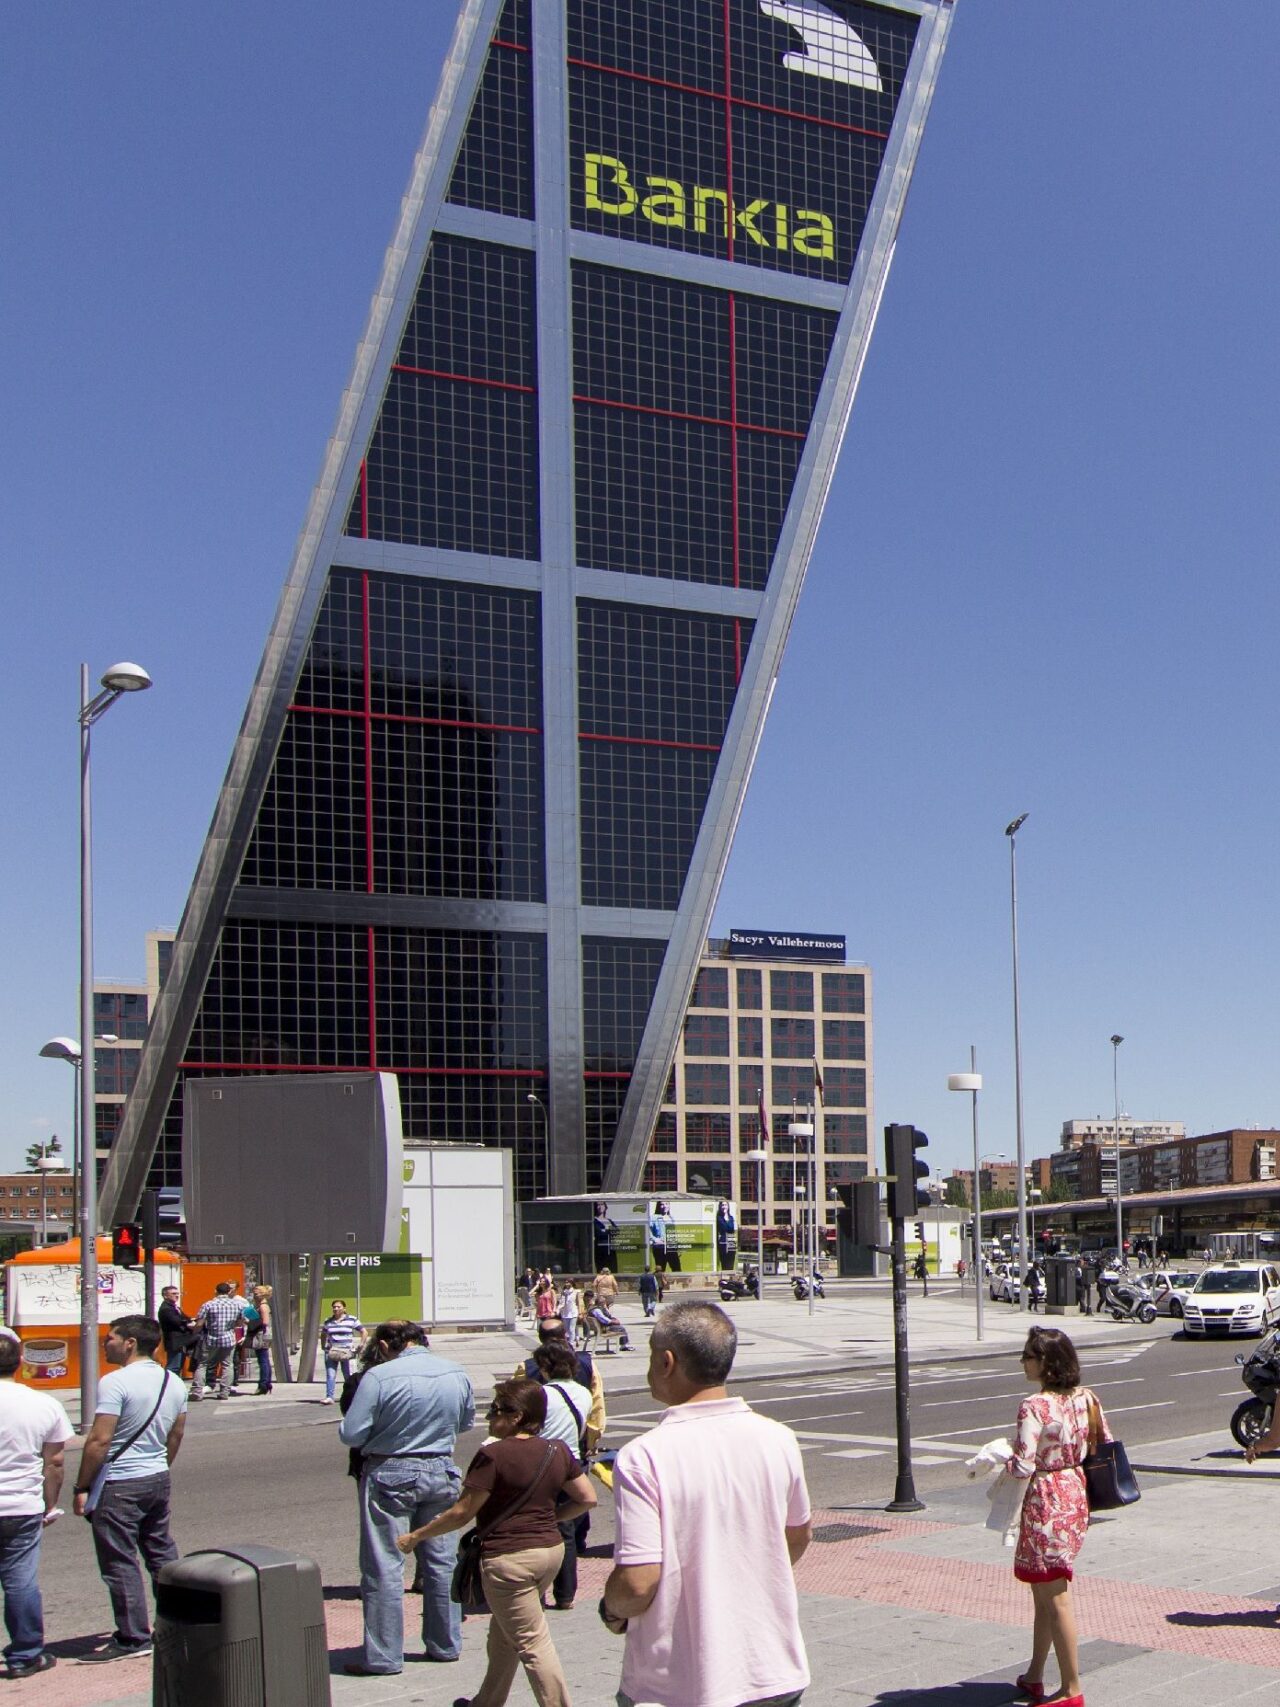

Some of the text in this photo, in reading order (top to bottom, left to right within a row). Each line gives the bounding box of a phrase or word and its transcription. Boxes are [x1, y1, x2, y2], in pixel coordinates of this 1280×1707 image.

[585, 153, 834, 261] Bankia
[731, 933, 844, 949] Sacyr Vallehermoso
[330, 1256, 381, 1267] EVERIS
